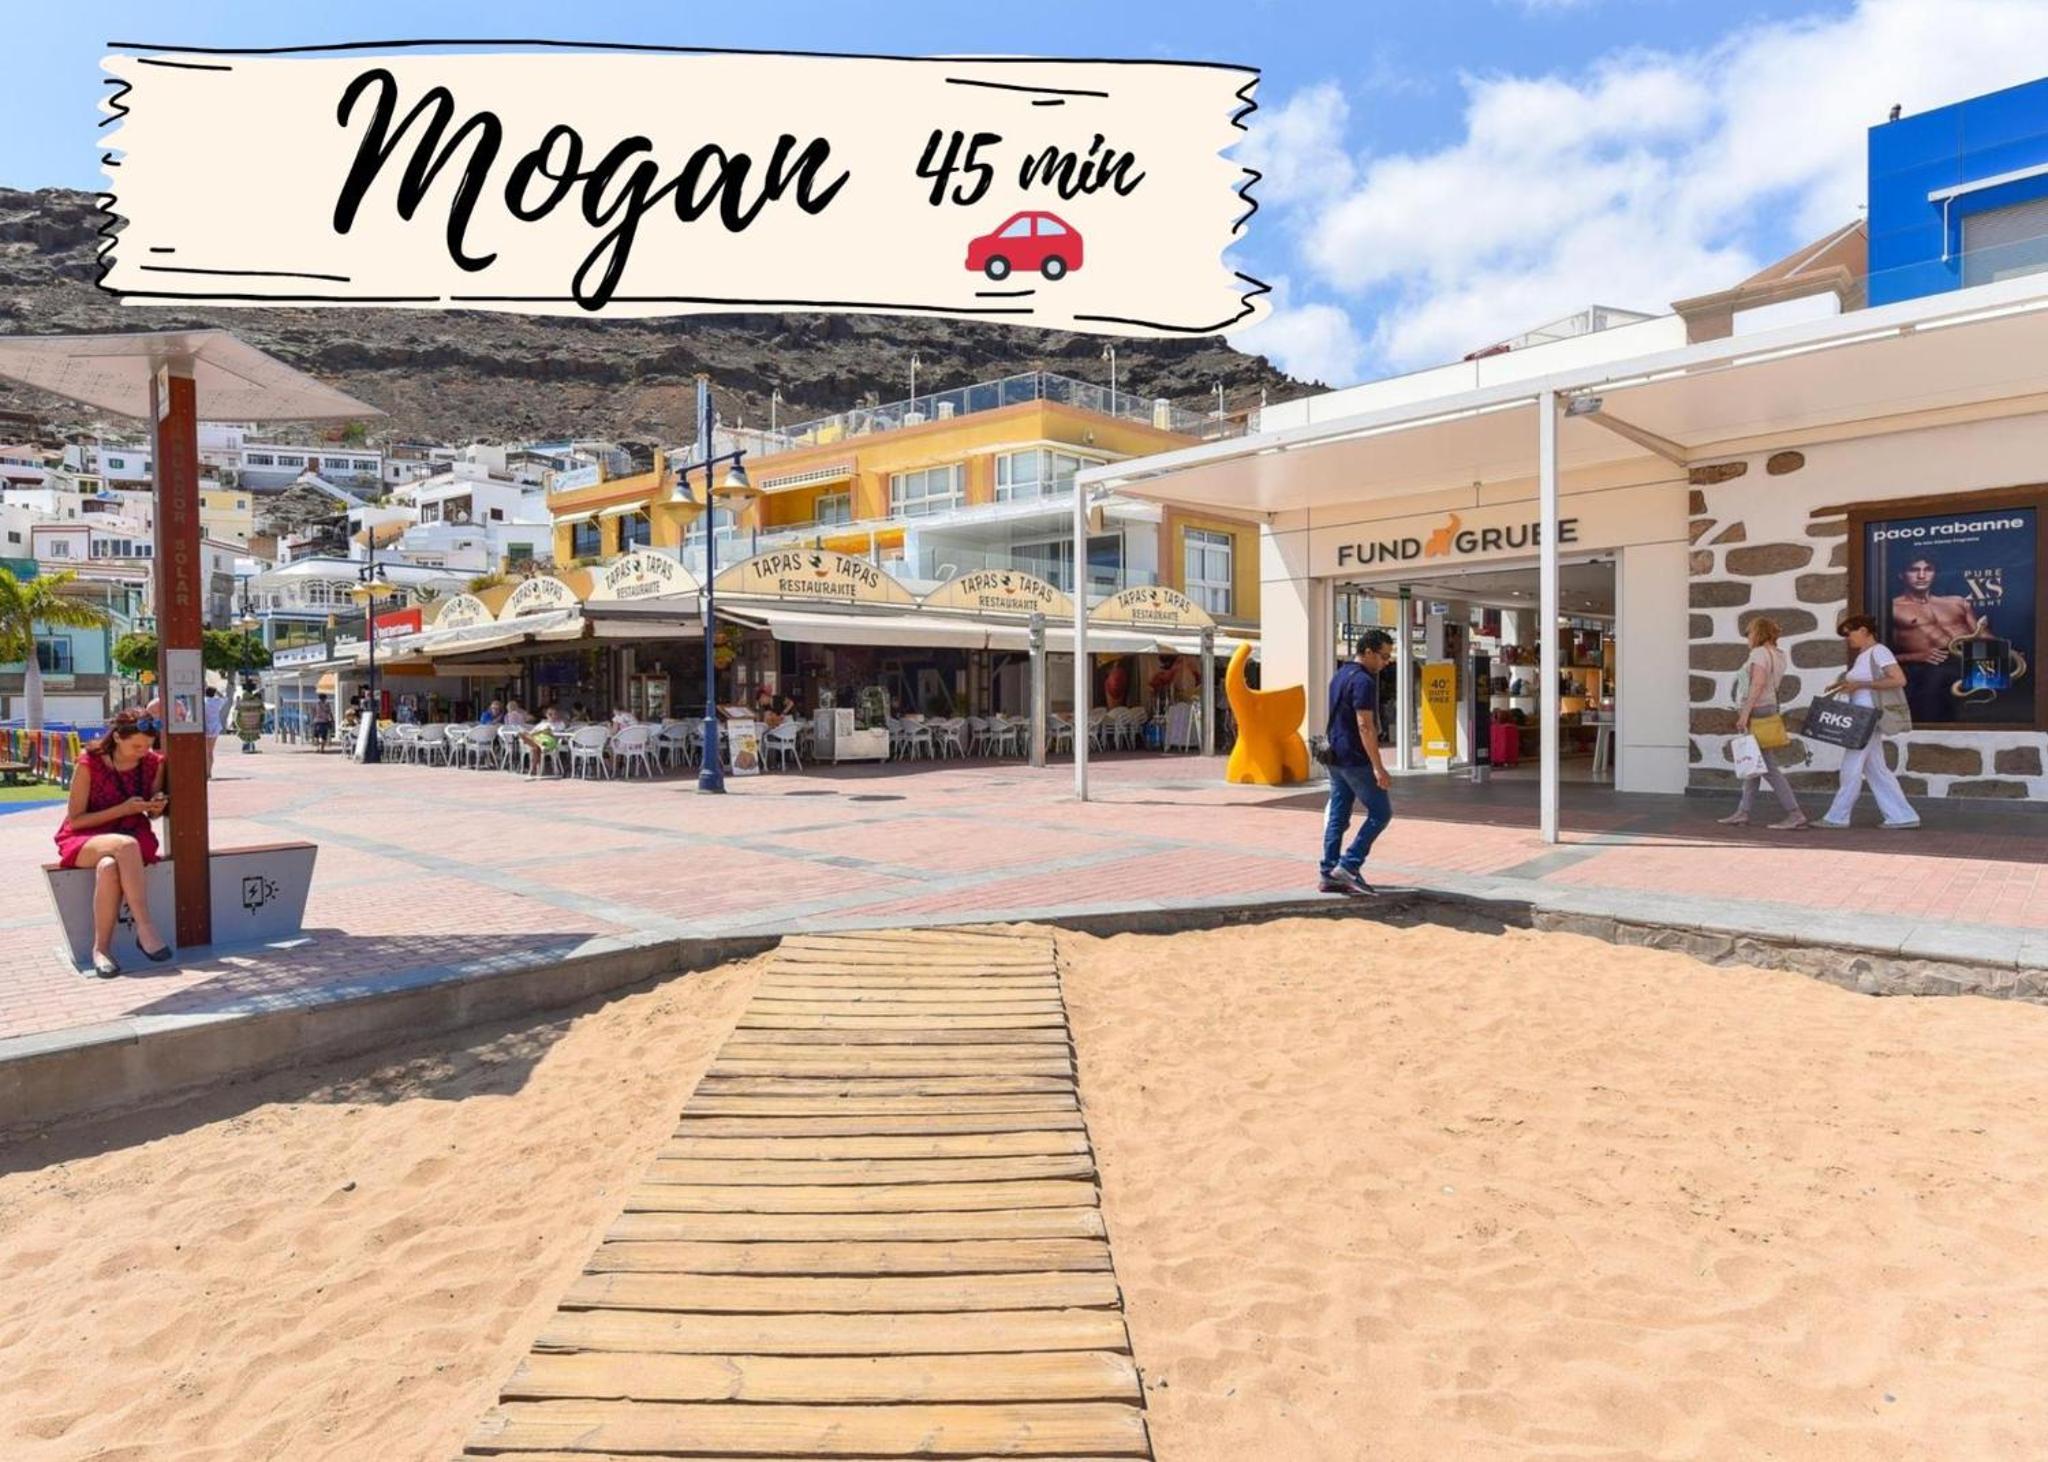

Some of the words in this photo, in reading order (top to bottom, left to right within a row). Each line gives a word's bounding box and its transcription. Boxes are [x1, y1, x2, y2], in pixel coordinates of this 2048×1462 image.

[1873, 527, 1926, 542] paco
[1930, 518, 2024, 535] rabanne
[1338, 538, 1421, 566] FUND
[174, 539, 189, 606] SOLAR
[605, 561, 631, 589] TAPAS
[647, 554, 674, 581] TAPAS
[752, 553, 802, 578] TAPAS
[836, 557, 879, 588] TAPAS
[1964, 568, 2003, 577] PURE
[617, 582, 661, 599] RESTAURANTE
[779, 579, 856, 596] RESTAURANTE
[961, 574, 998, 594] TAPAS
[1019, 576, 1053, 602] TAPAS
[1966, 578, 2004, 600] XS
[979, 595, 1038, 611] RESTAURANTE
[1119, 590, 1147, 607] TAPAS
[1163, 590, 1192, 613] TAPAS
[1132, 608, 1178, 621] RESTAURANTE
[1819, 711, 1853, 728] RKS
